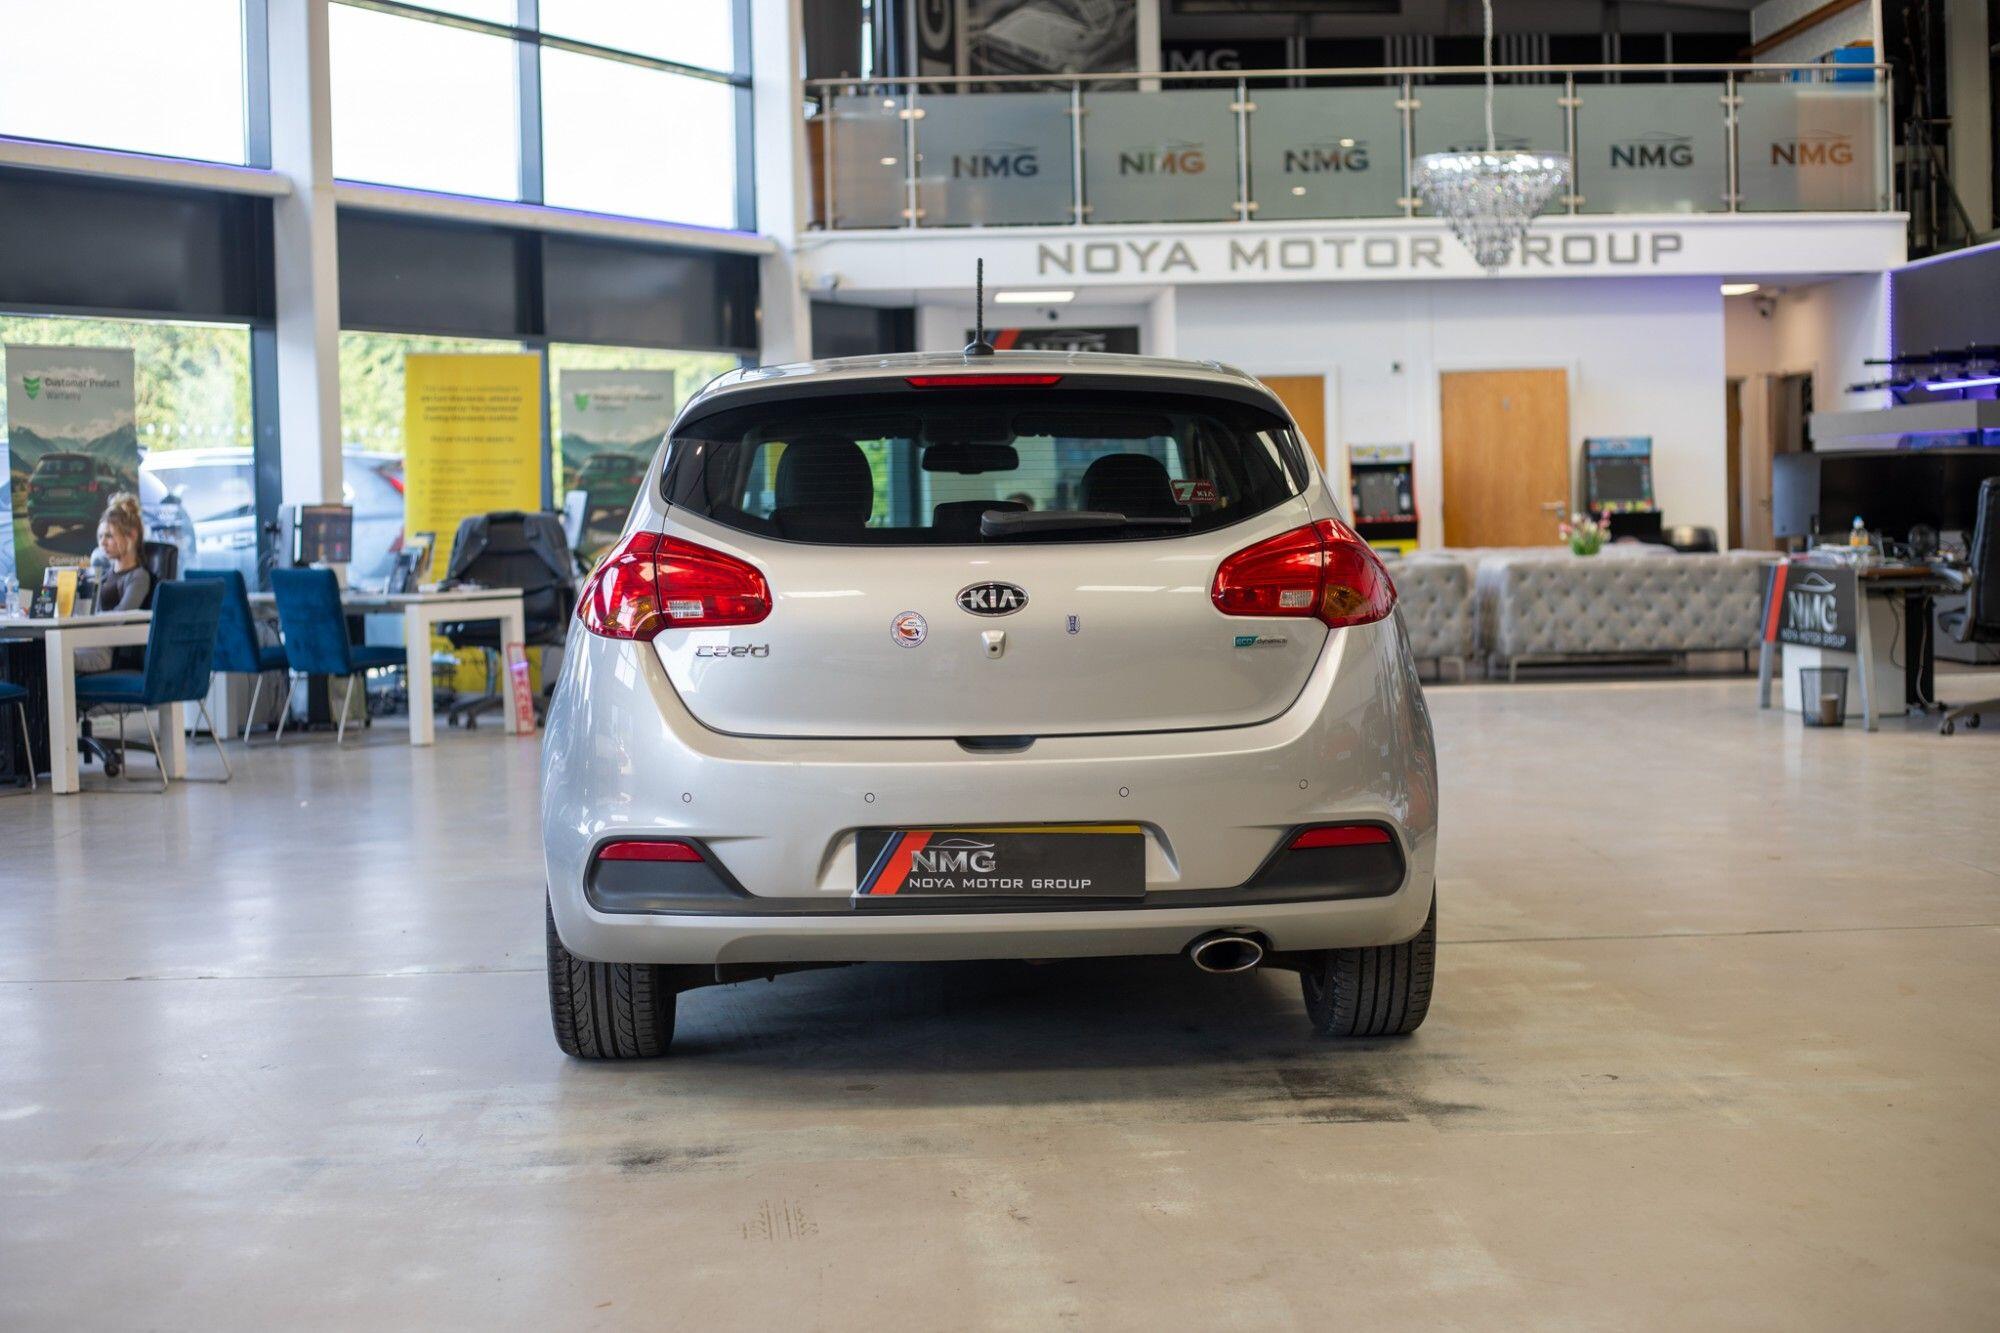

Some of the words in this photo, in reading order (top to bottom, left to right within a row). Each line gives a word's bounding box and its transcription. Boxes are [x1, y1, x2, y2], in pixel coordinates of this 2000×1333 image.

[1160, 49, 1242, 71] MG
[1119, 151, 1205, 176] NMG
[1283, 149, 1370, 174] NMG
[1610, 143, 1694, 168] NMG
[1771, 141, 1854, 165] NMG
[953, 153, 1039, 178] NMG
[1037, 240, 1199, 275] NOYA
[1228, 236, 1444, 271] MOTOR
[1475, 232, 1684, 267] ROUP
[1174, 481, 1198, 501] 7
[969, 588, 1019, 609] KIA
[1788, 590, 1838, 633] NMG
[910, 849, 996, 873] NMG
[909, 878, 954, 889] NOYA
[962, 878, 1024, 889] MOTOR
[1031, 878, 1092, 889] GROUP
